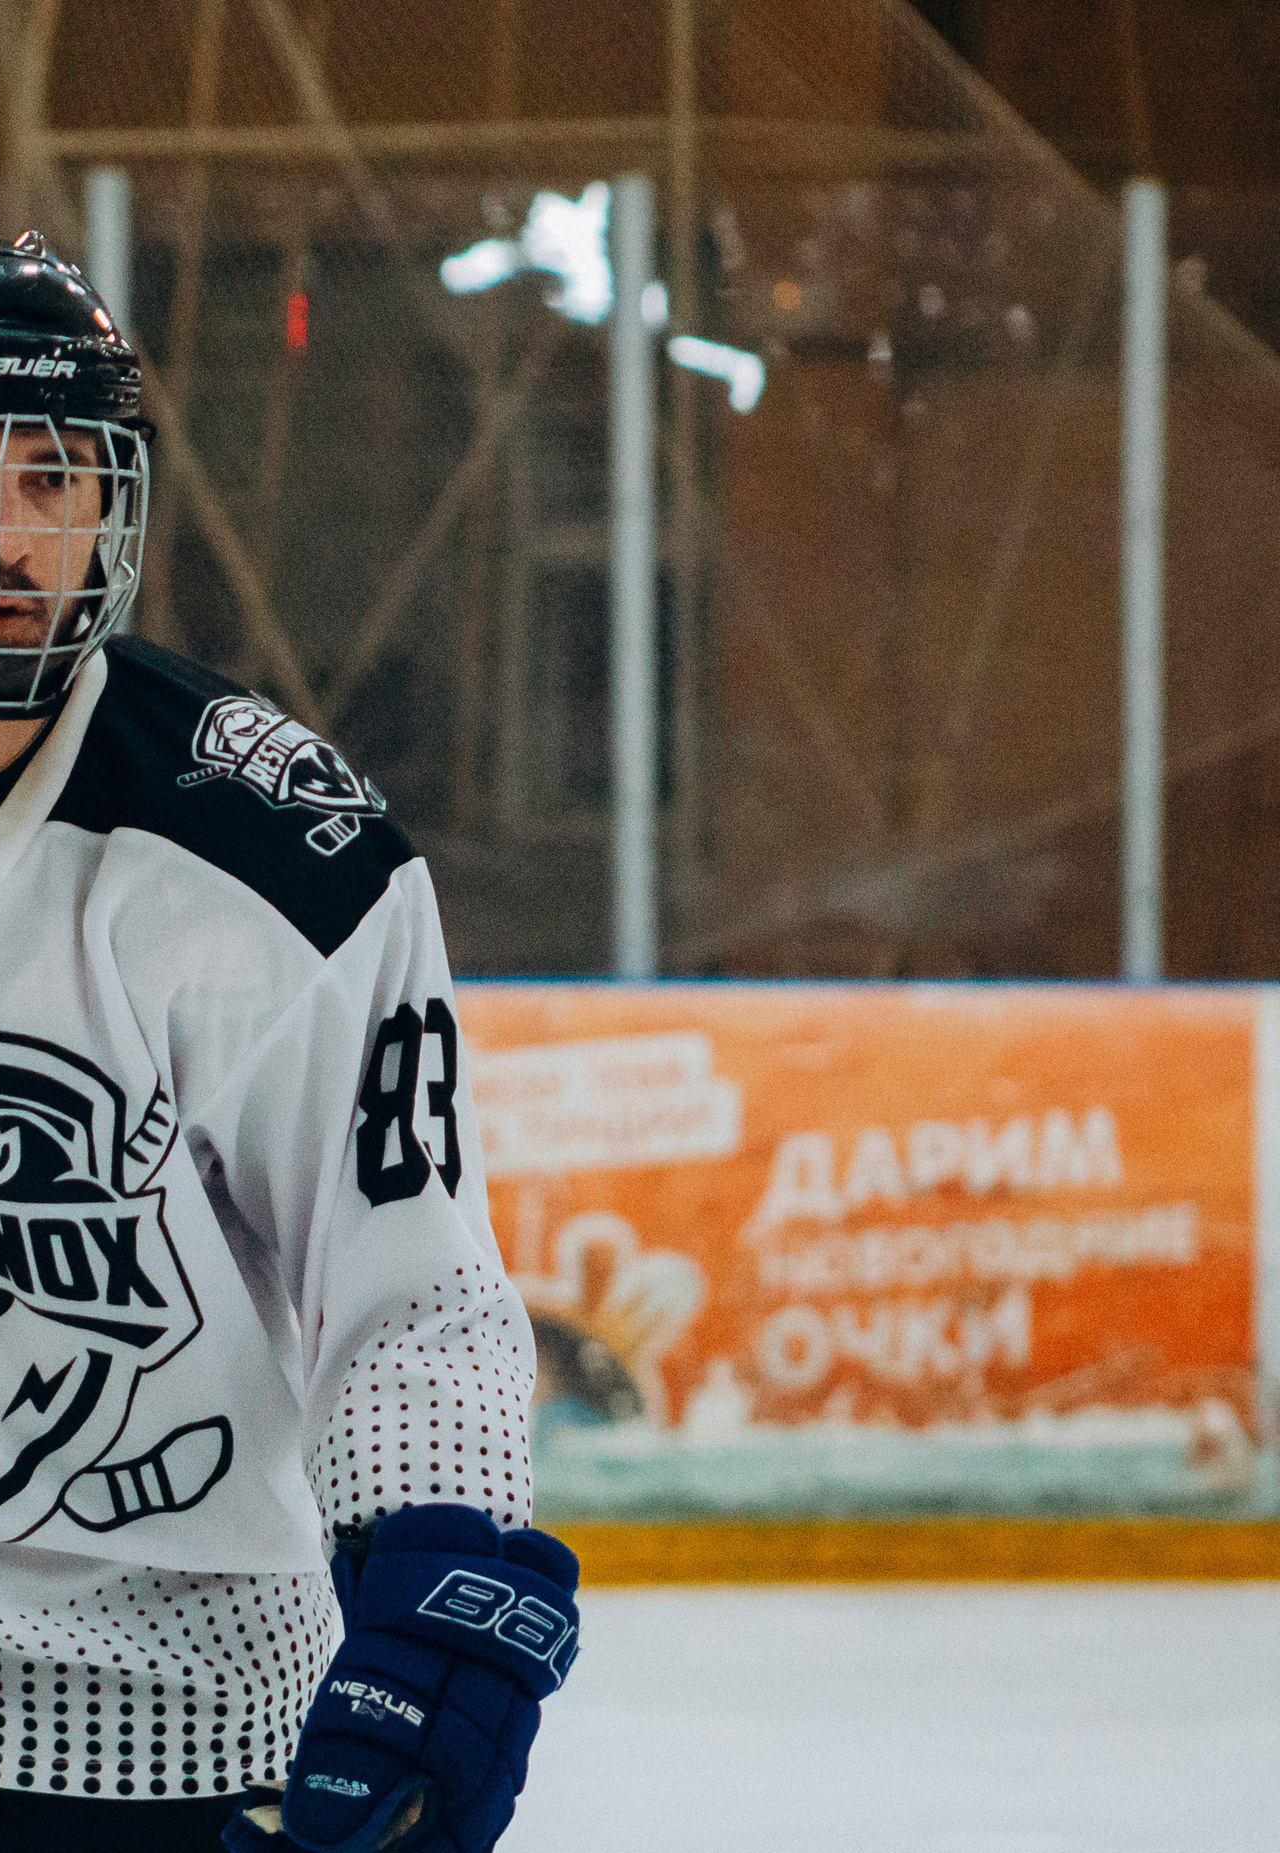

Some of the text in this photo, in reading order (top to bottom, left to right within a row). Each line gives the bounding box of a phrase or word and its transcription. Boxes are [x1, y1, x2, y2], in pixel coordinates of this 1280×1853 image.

[357, 998, 462, 1208] 83
[743, 1107, 1122, 1243] ДАРИМ
[760, 1283, 1032, 1388] ОЧКИ
[329, 1680, 425, 1727] NEXUS
